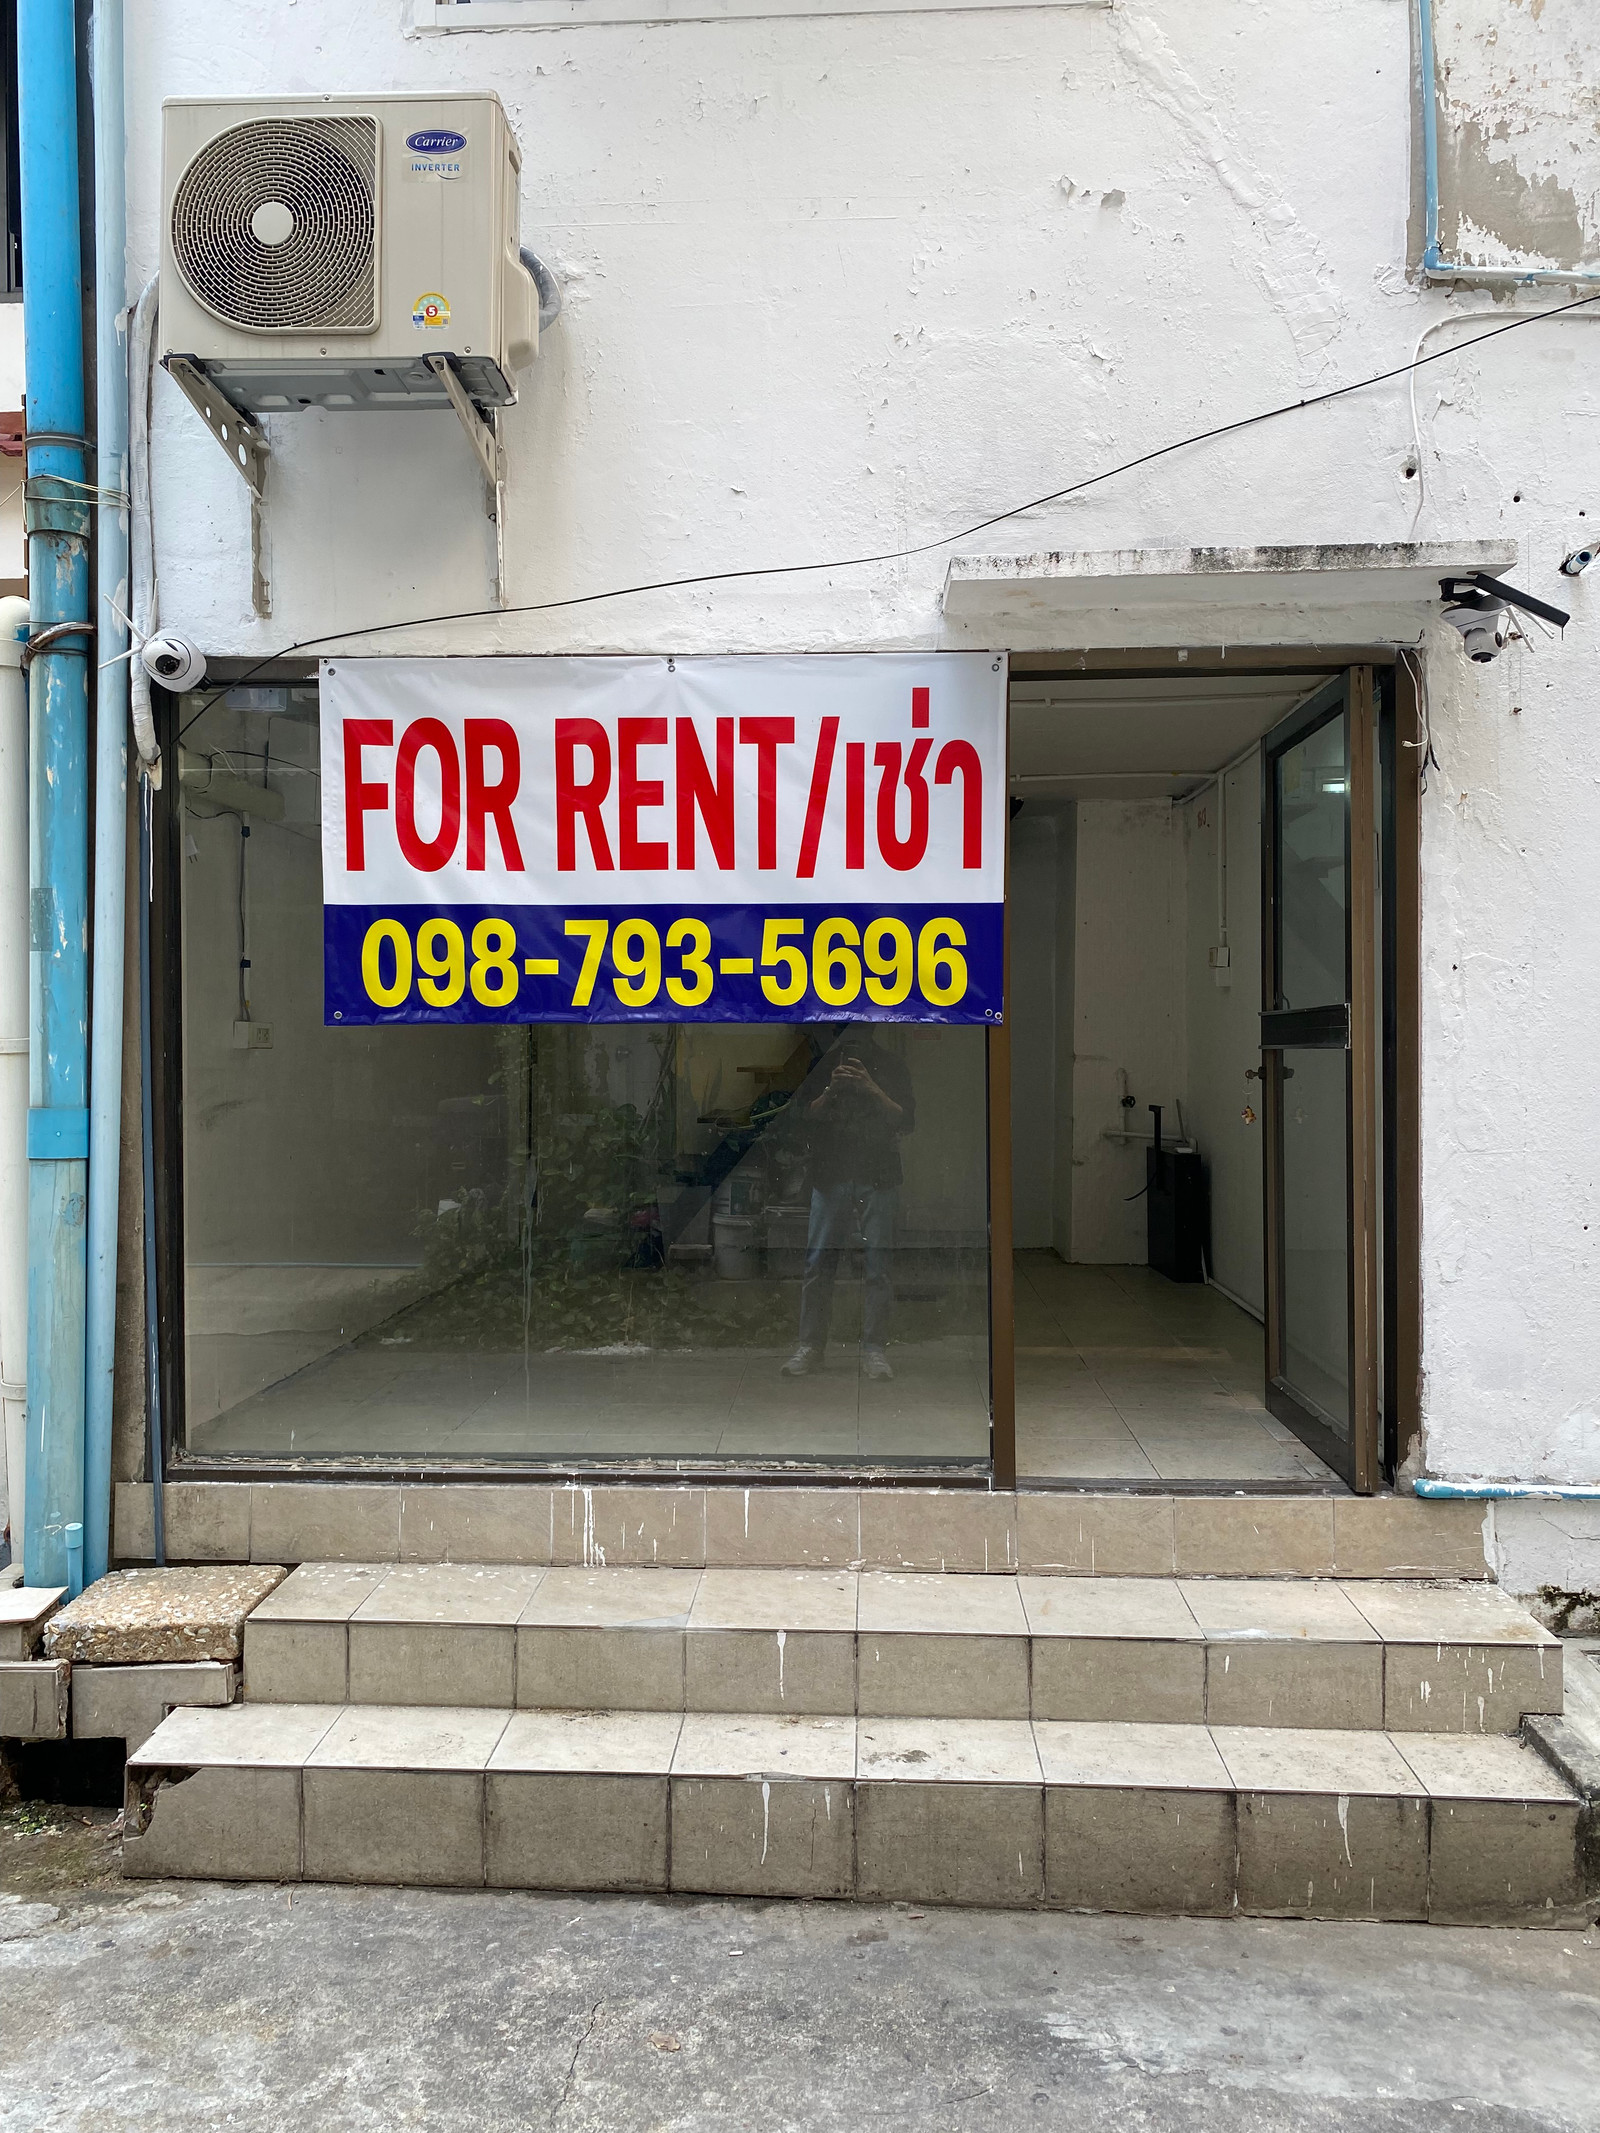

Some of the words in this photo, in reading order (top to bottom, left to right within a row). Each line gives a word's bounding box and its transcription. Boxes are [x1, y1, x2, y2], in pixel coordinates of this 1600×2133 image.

[415, 136, 458, 147] Carrier
[411, 163, 460, 171] INVERTER
[428, 306, 436, 316] 5
[343, 718, 524, 872] FOR
[362, 918, 967, 1007] 098-793-5696
